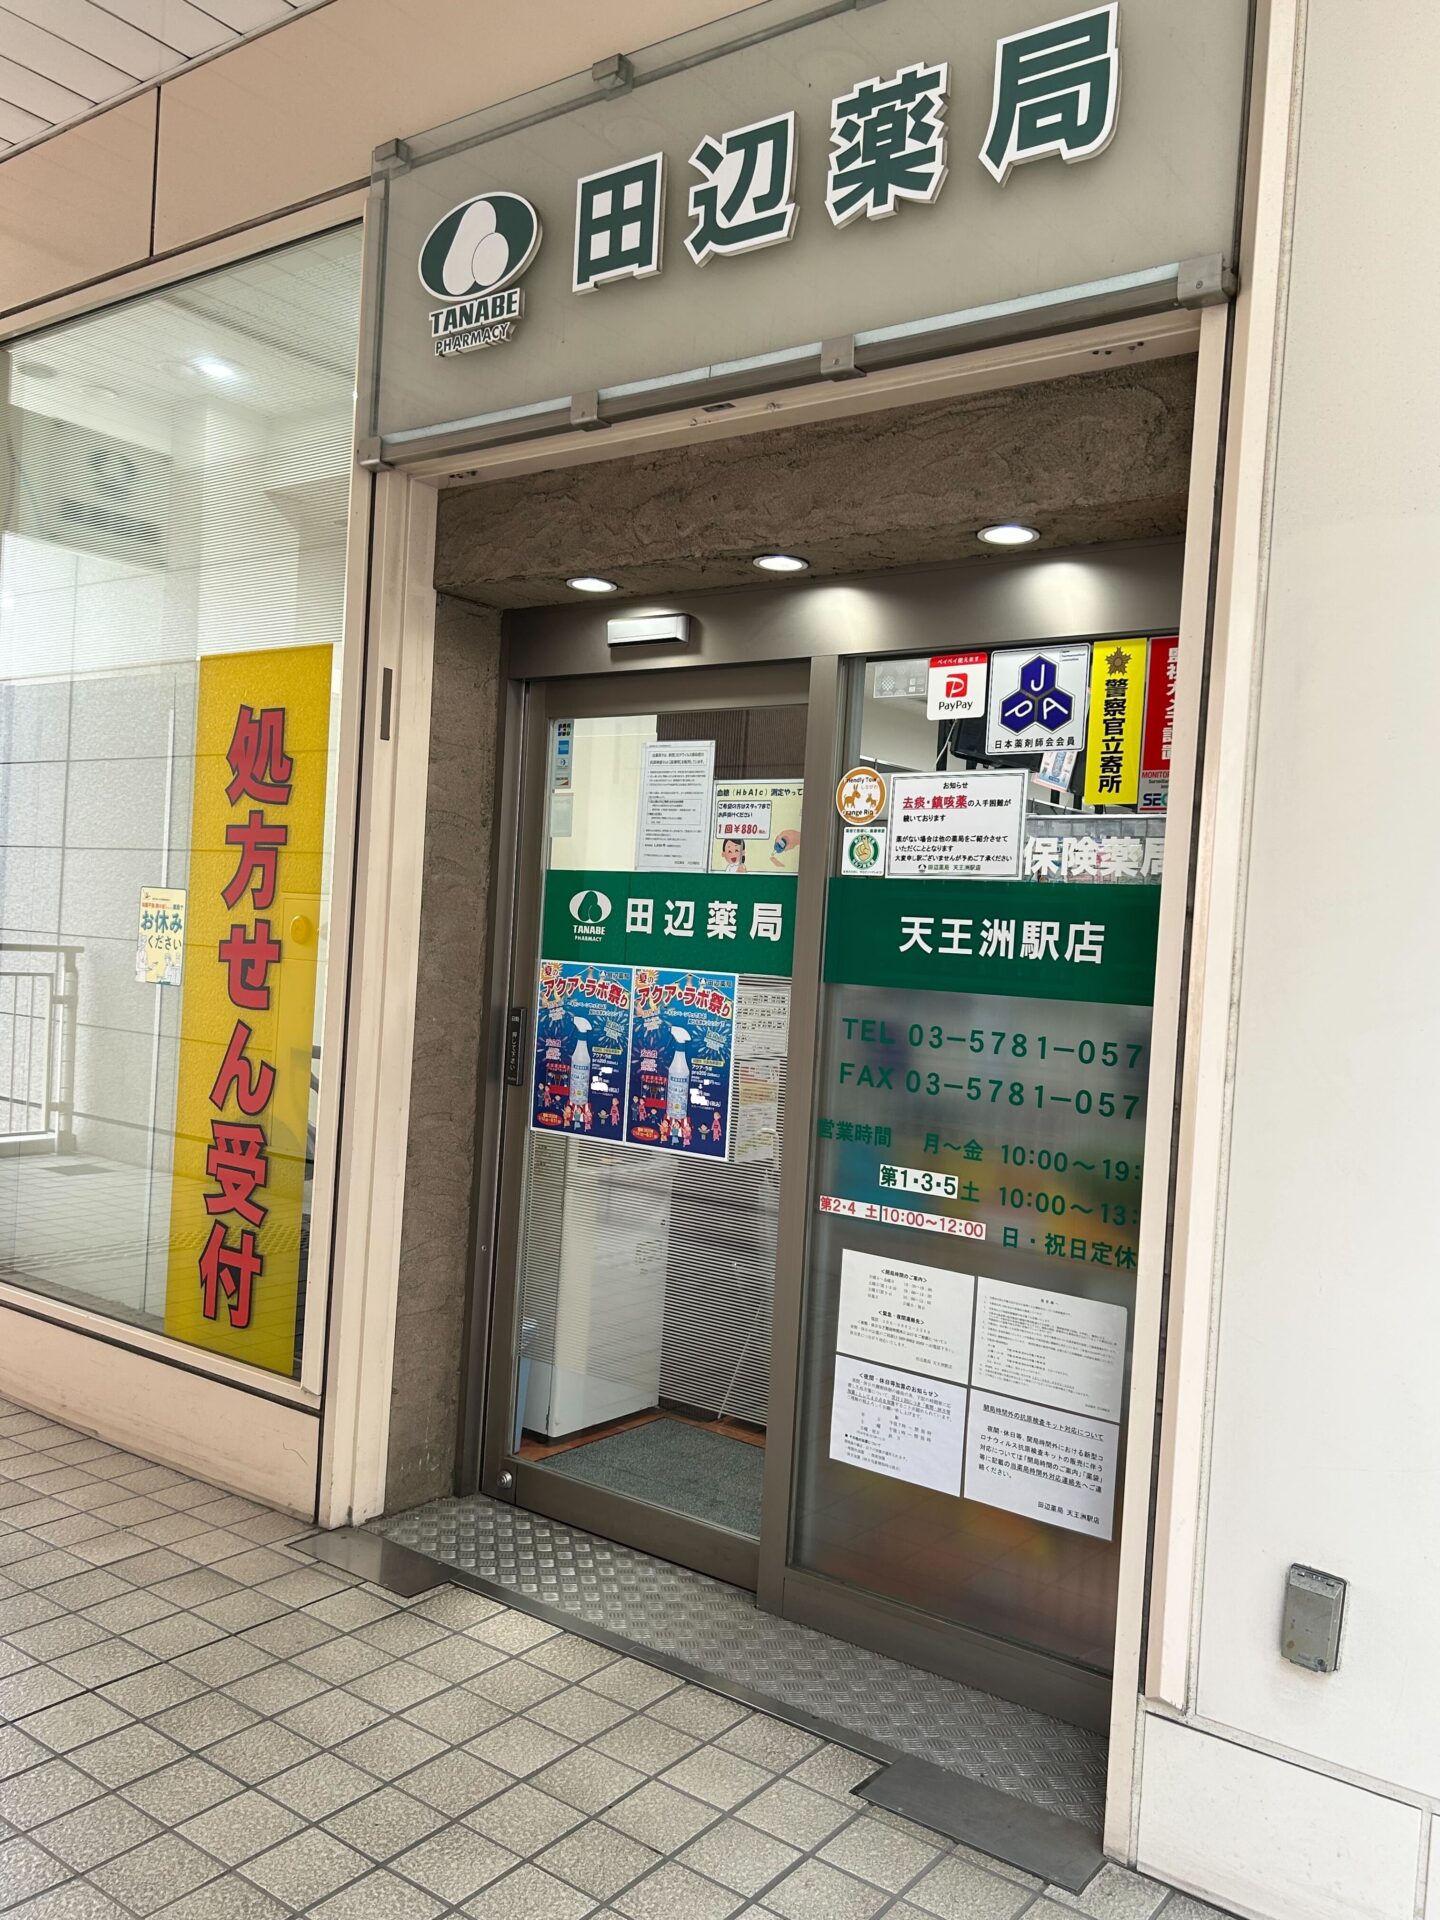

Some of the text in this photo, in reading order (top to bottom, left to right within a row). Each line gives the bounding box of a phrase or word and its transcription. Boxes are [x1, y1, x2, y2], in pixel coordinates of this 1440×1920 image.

[572, 3, 1120, 294] 田辺薬局
[430, 288, 520, 338] TANABE
[434, 322, 511, 356] PHARMACY
[938, 700, 974, 711] PayPay
[994, 736, 1076, 749] 日本薬剤師会会員
[1098, 678, 1128, 794] 警察官立寄所
[903, 814, 946, 822] 続いております
[1023, 836, 1165, 877] 保険薬局
[141, 910, 182, 933] お休み
[573, 925, 606, 935] TANABE
[626, 898, 783, 942] 田辺薬局
[147, 935, 182, 950] ください
[899, 916, 1105, 965] 天王洲駅店
[543, 978, 629, 1009] アクア・ラボ祭り
[638, 985, 731, 1018] アクア・ラボ祭り
[197, 702, 294, 1329] 処方せん受付
[842, 1017, 896, 1044] TEL
[839, 1062, 895, 1090] FAX
[817, 1118, 892, 1148] 営業時間
[960, 1181, 980, 1203] 土
[865, 1204, 878, 1219] 土
[1002, 1226, 1138, 1269] 日・祝日定休
[983, 1403, 1104, 1441] 開局時間外の抗原検査キット対応について
[978, 1463, 1012, 1478] 絡ください。
[1038, 1501, 1100, 1525] 田辺薬局 天王洲駅店
